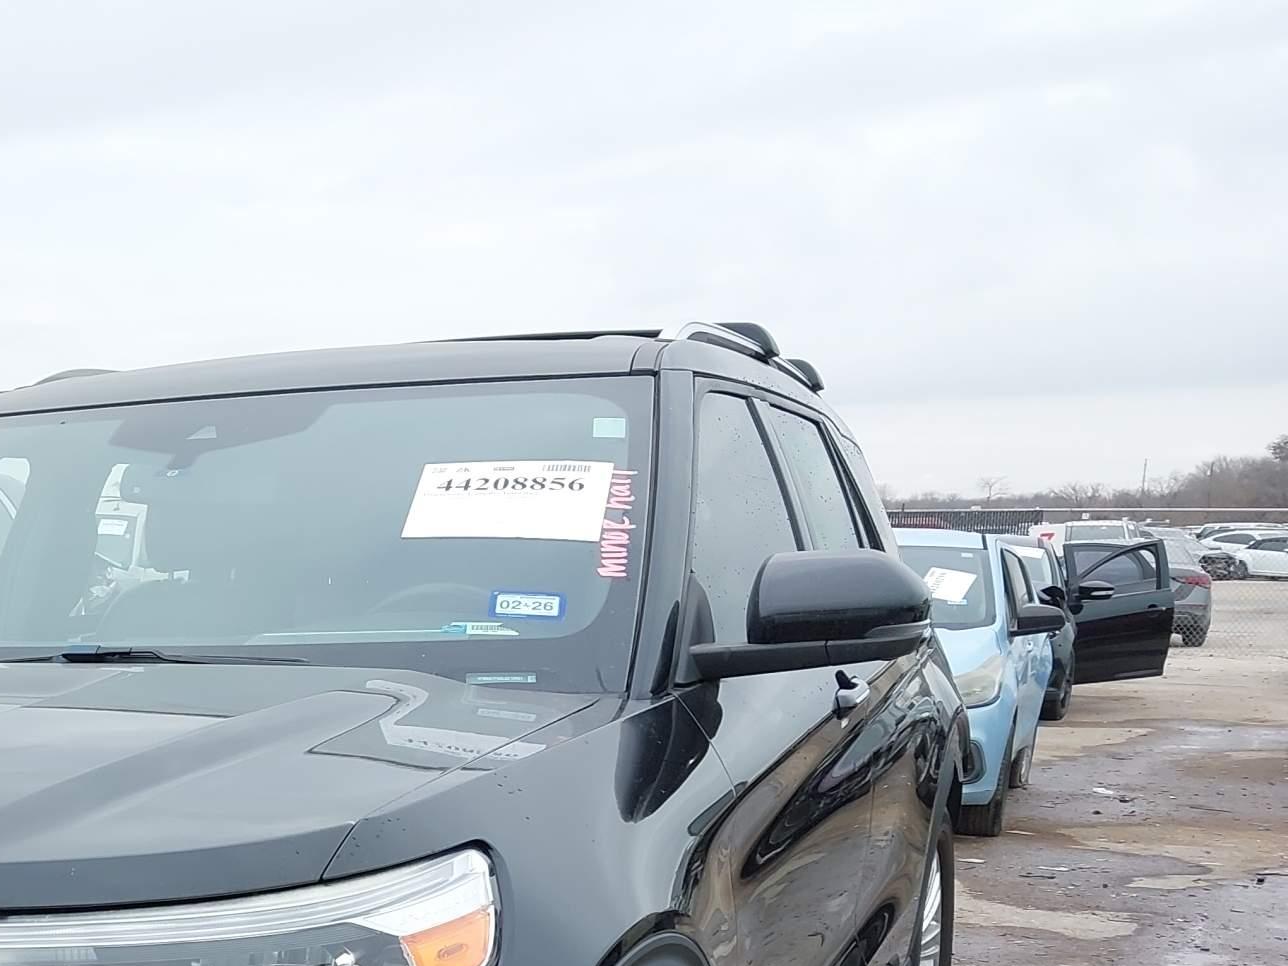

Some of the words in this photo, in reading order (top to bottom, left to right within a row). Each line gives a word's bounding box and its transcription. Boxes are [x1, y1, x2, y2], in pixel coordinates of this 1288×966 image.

[436, 477, 585, 492] 44208856
[499, 600, 522, 611] 02
[531, 601, 554, 612] 26
